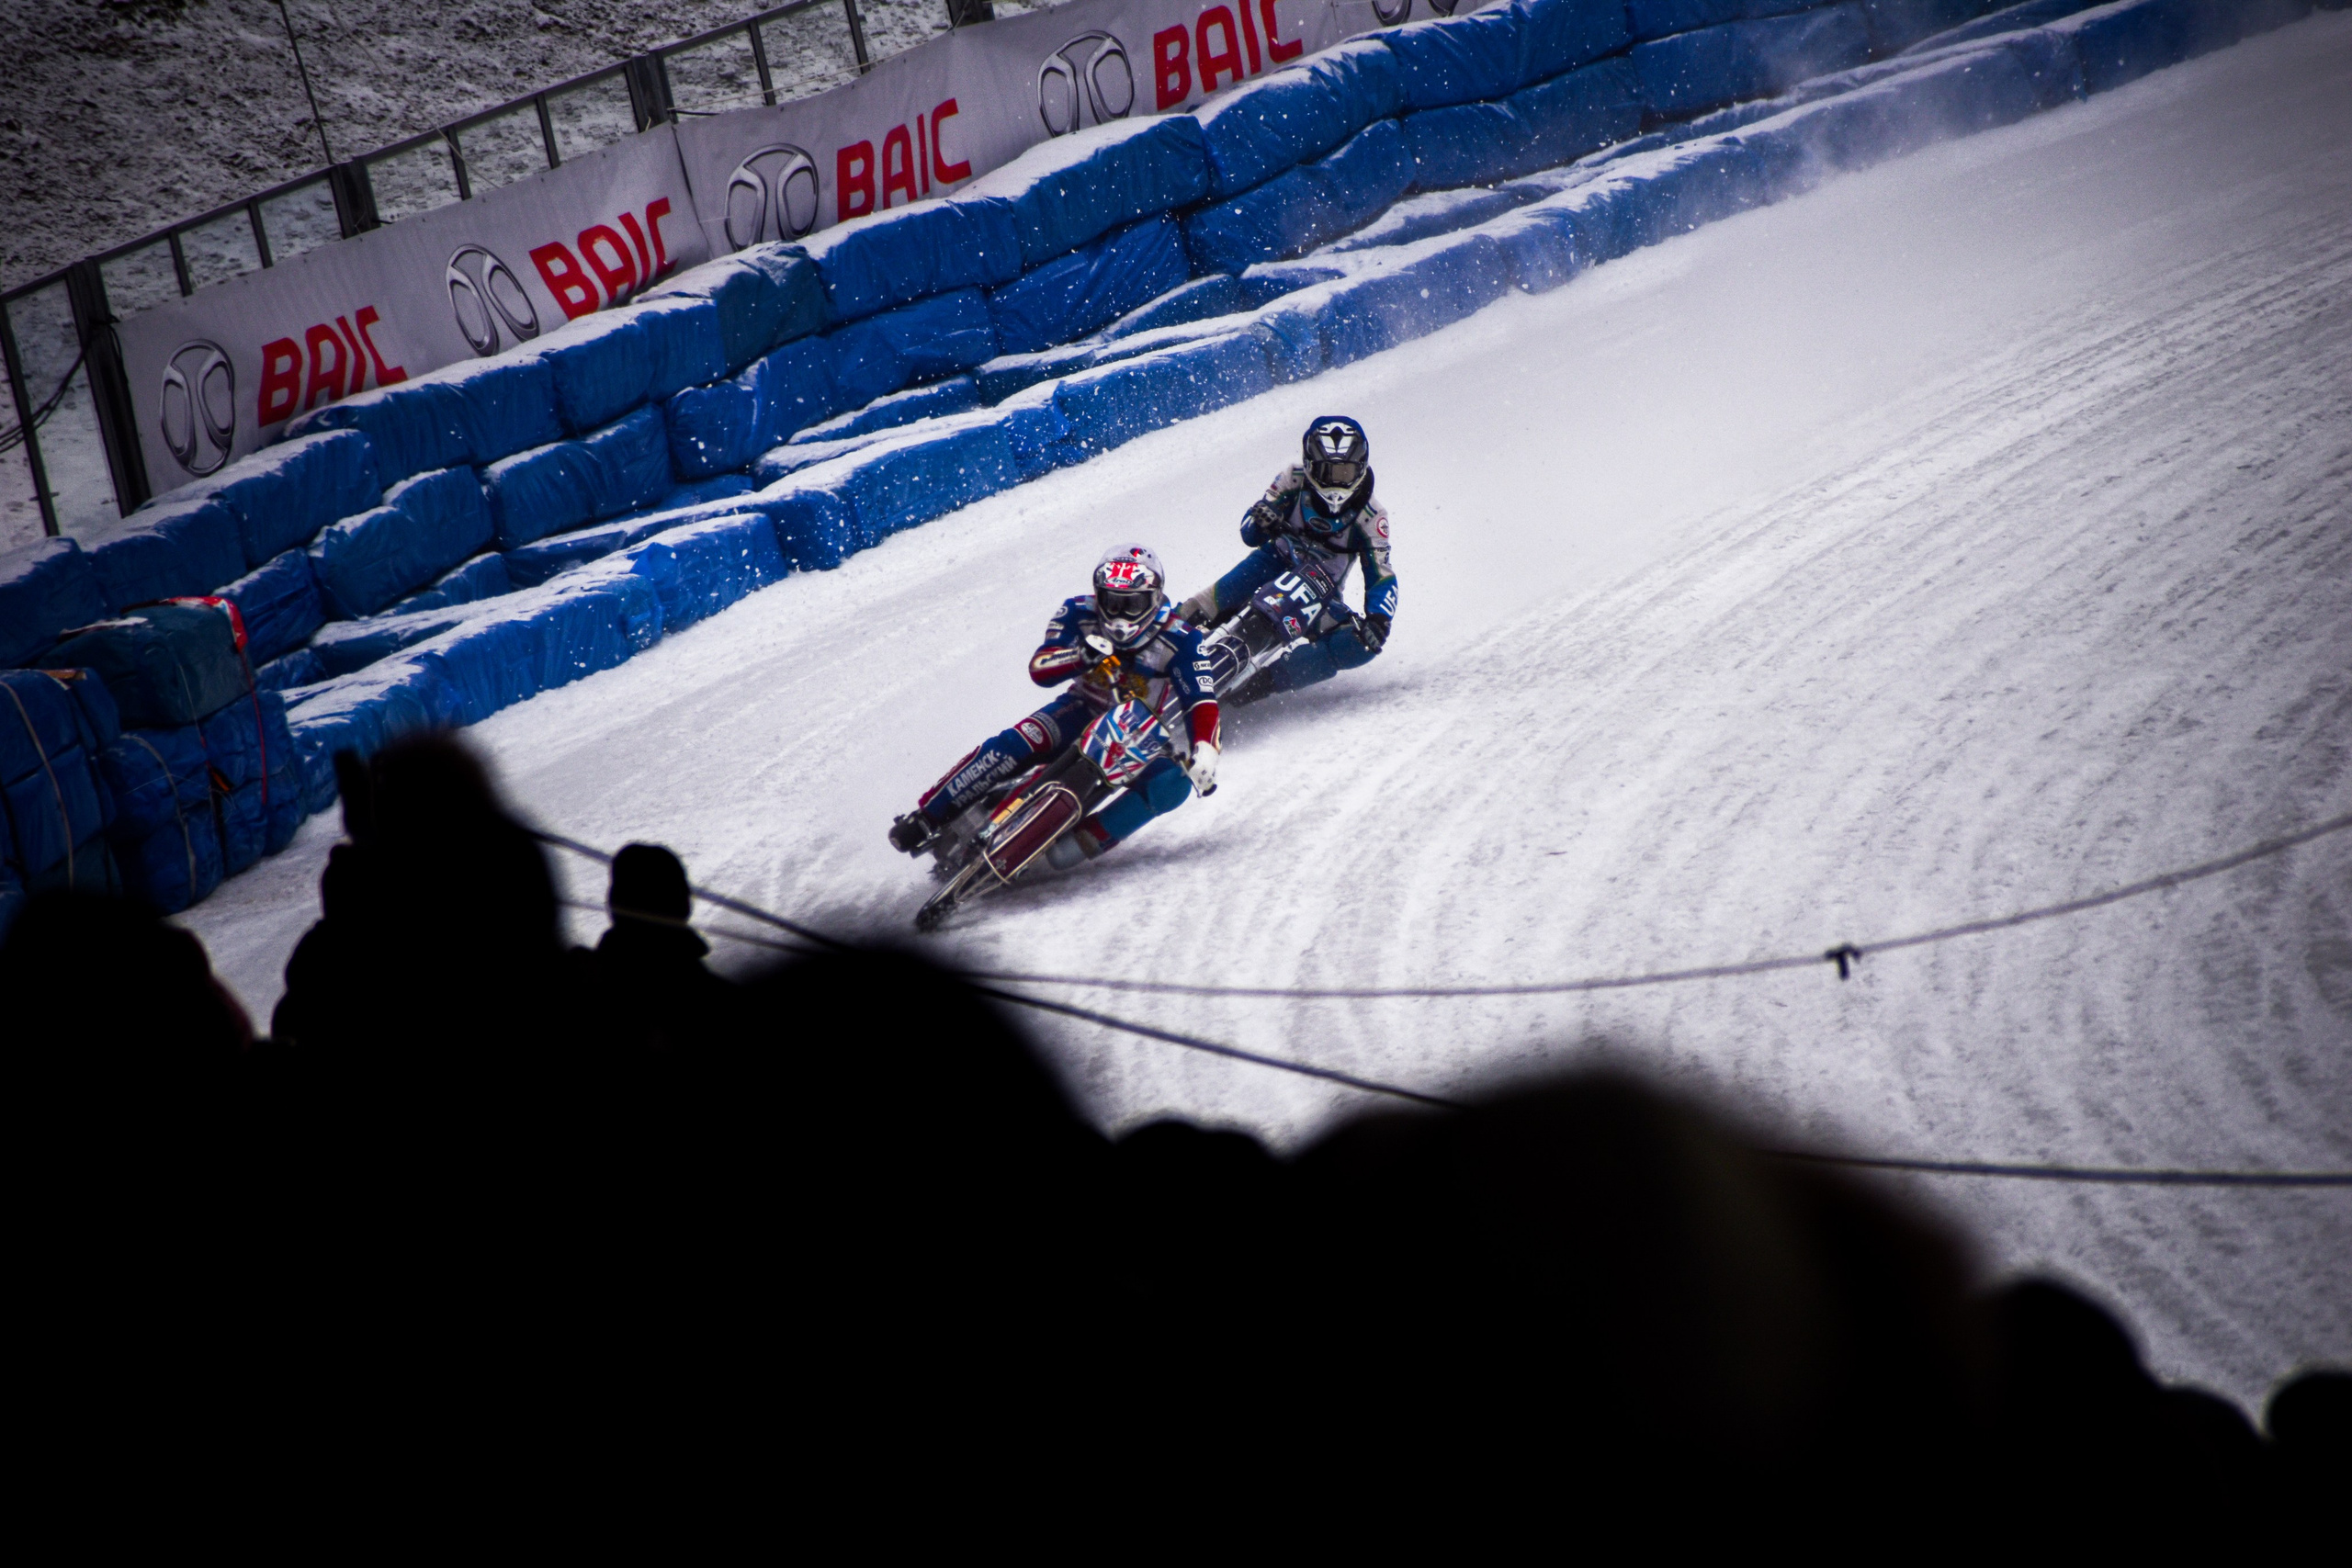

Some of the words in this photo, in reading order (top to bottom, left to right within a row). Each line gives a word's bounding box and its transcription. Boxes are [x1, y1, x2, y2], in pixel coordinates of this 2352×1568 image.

[1153, 0, 1303, 111] BAIC
[837, 97, 972, 223] BAIC
[528, 196, 679, 321] BAIC
[258, 305, 409, 428] BAIC
[1274, 570, 1323, 626] UFA
